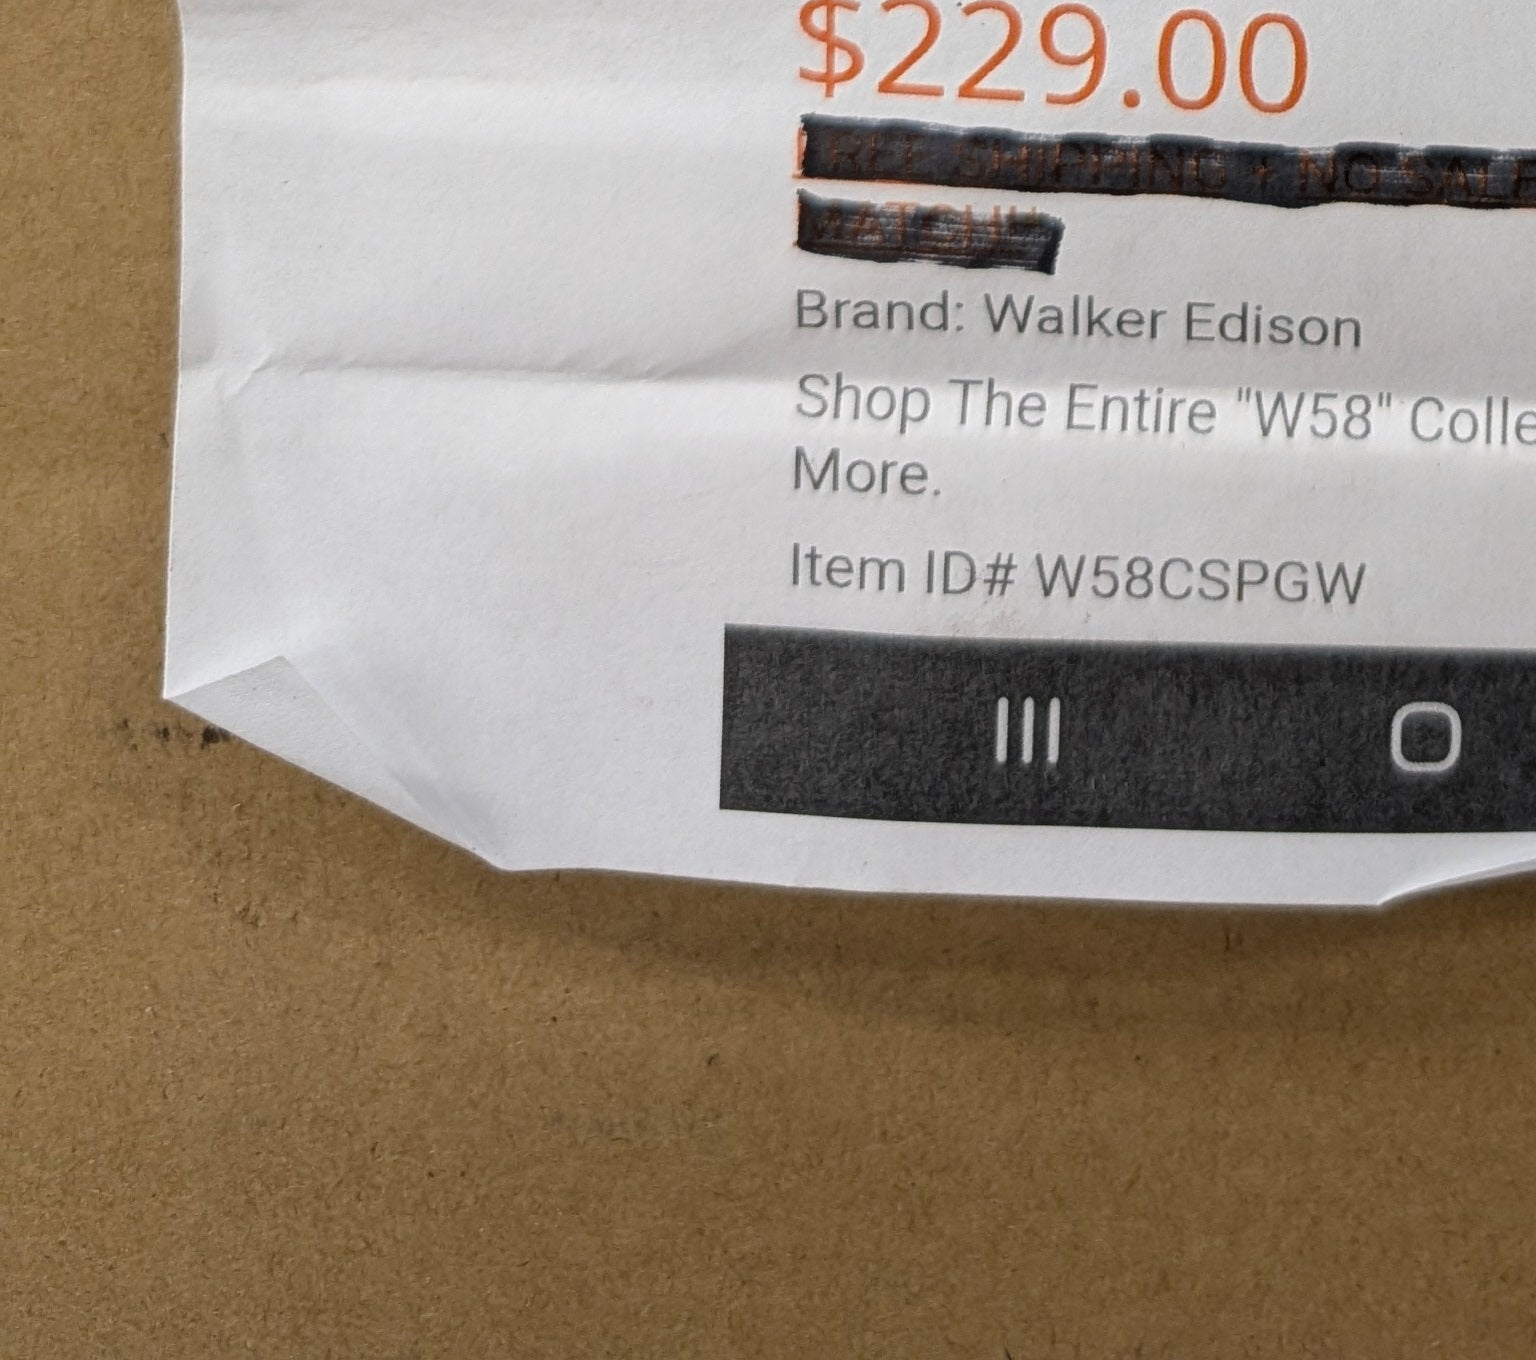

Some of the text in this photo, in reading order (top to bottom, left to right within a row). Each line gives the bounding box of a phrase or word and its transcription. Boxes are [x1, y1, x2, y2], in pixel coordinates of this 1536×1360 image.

[796, 289, 1361, 349] Brand: Walker Edison
[796, 371, 930, 435] Shop
[948, 377, 1047, 428] The
[1066, 382, 1217, 435] Entire
[1237, 386, 1392, 441] "W58"
[793, 446, 941, 498] More.
[791, 542, 1366, 606] Item ID# W58CSPGW
